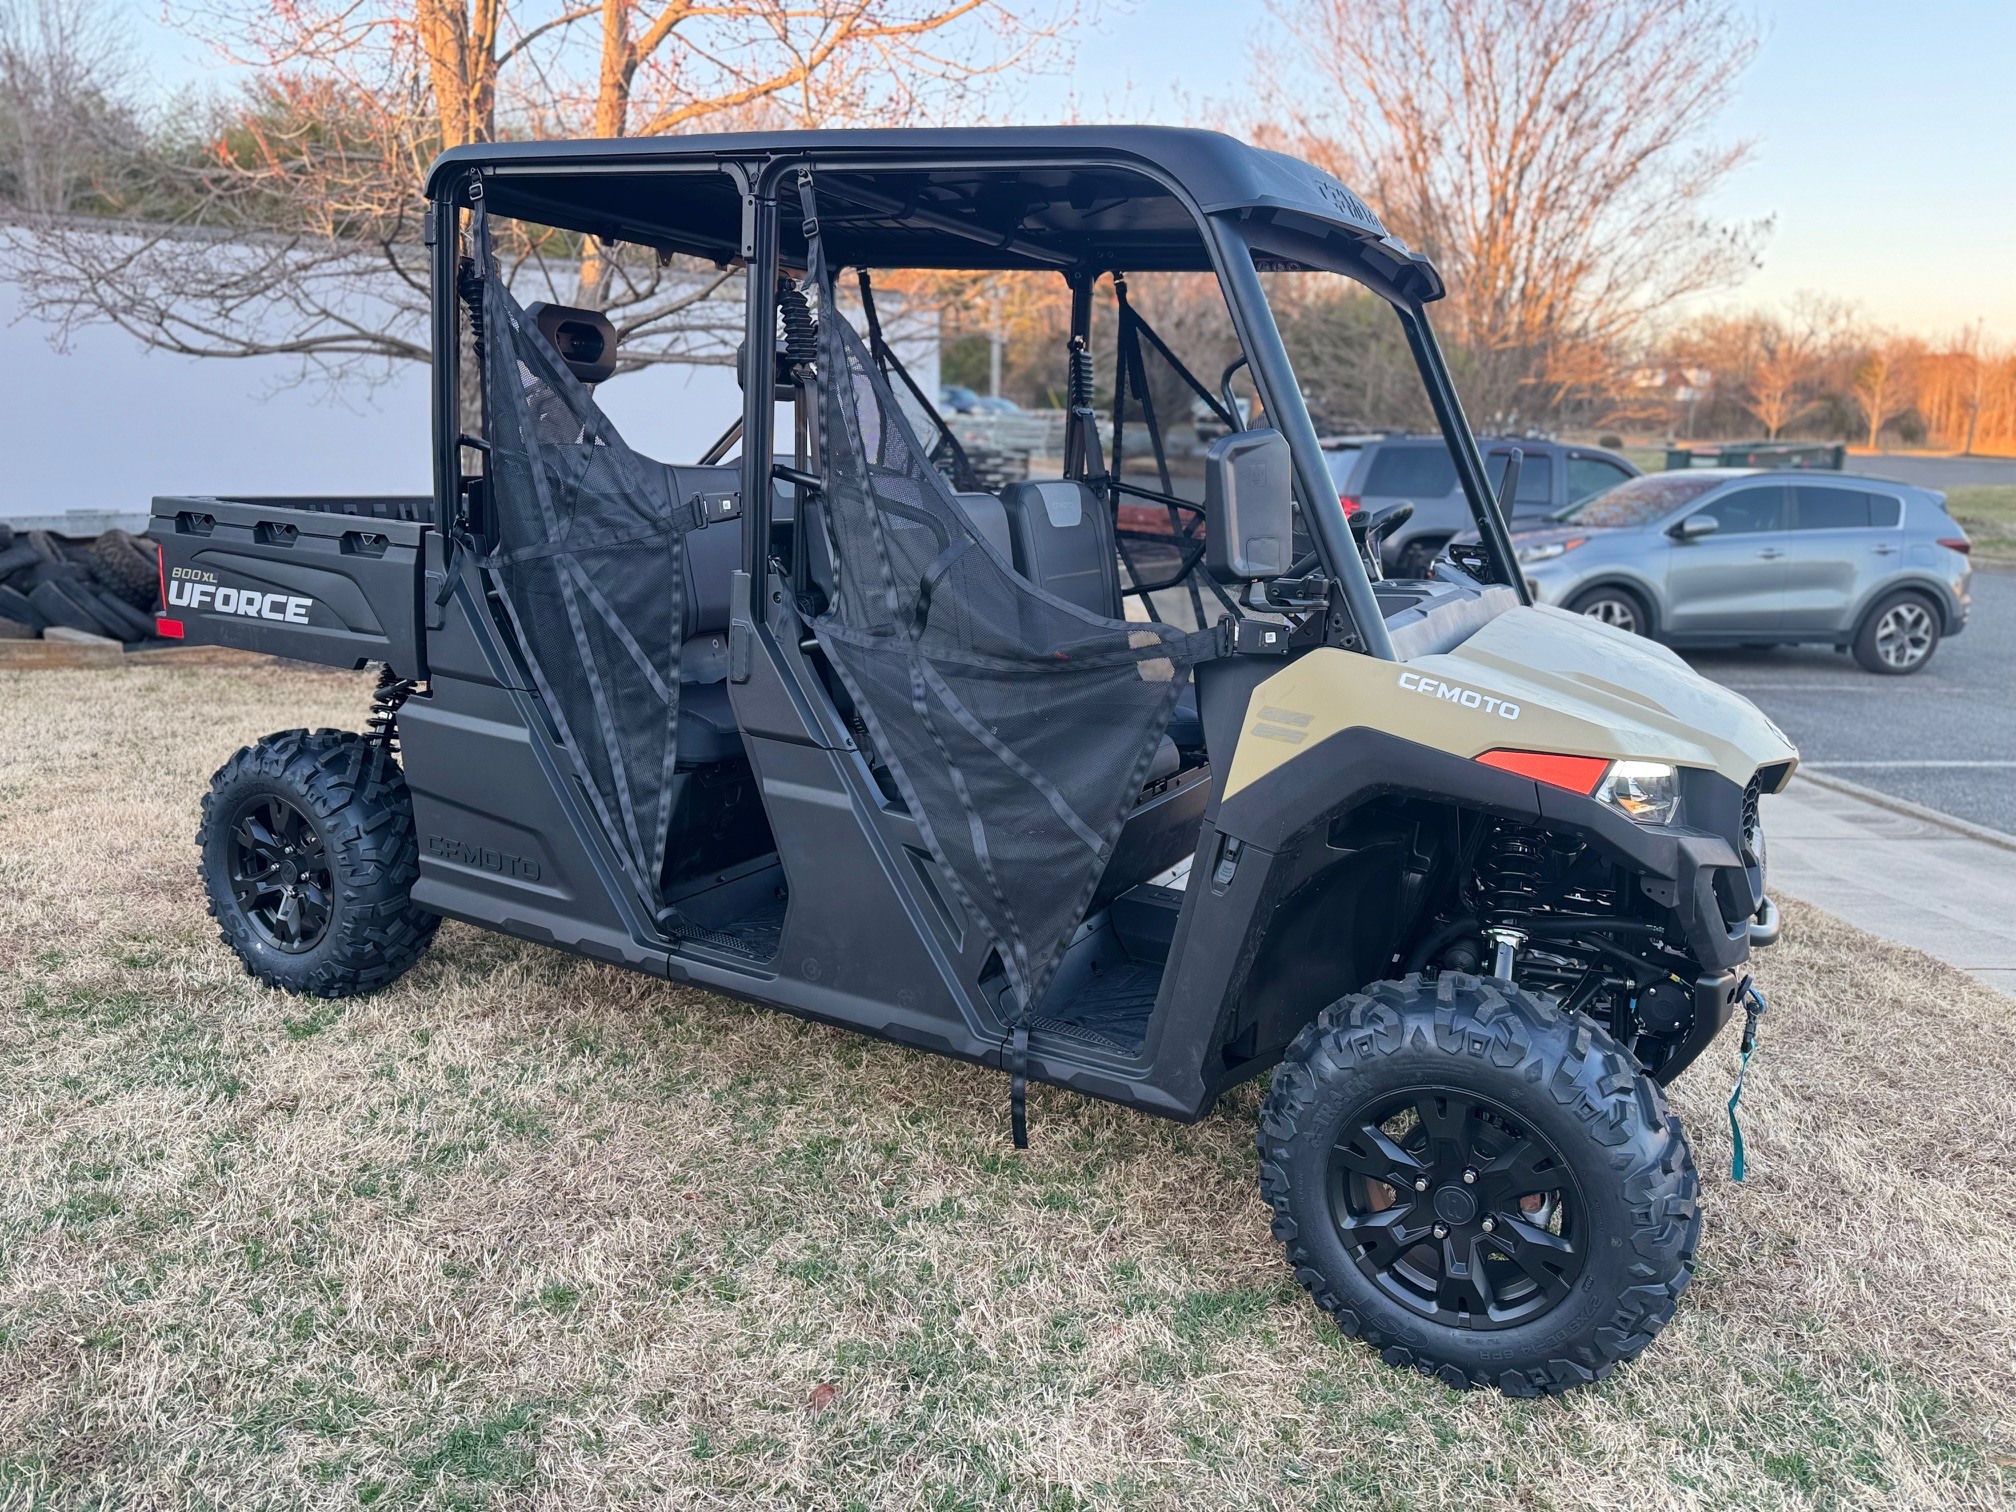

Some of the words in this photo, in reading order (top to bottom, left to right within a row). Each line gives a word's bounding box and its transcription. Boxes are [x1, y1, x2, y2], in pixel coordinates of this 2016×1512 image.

[168, 580, 313, 624] UFORCE
[1399, 672, 1520, 720] CFMOTO
[427, 833, 541, 882] CFMOTO
